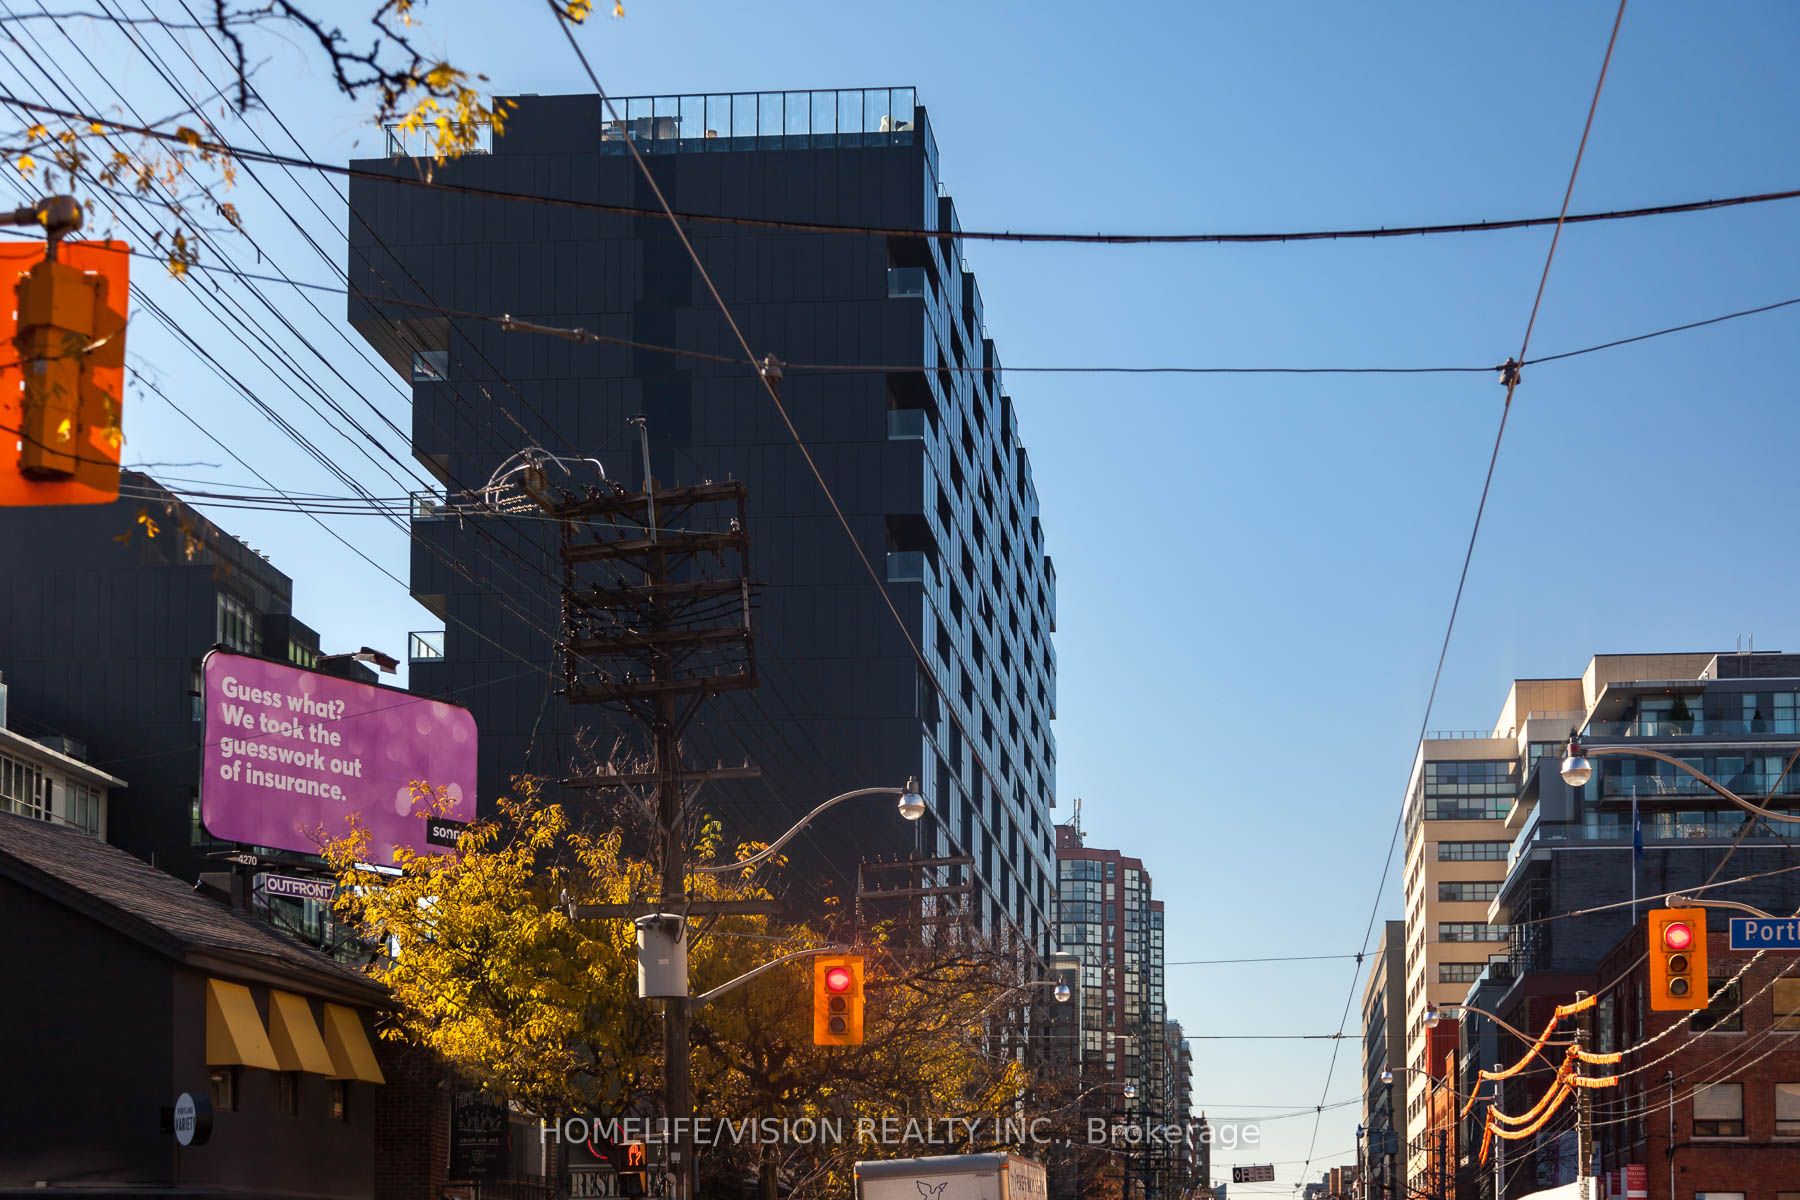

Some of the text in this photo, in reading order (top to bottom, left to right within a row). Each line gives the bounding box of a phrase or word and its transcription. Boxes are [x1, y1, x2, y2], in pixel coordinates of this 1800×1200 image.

[222, 676, 345, 720] Guess what?
[221, 702, 341, 747] We took the
[220, 737, 362, 778] guesswork out
[220, 760, 347, 801] of insurance.
[239, 855, 258, 866] 4270
[267, 878, 330, 897] OUTFRONT
[175, 1116, 194, 1131] VARIETY
